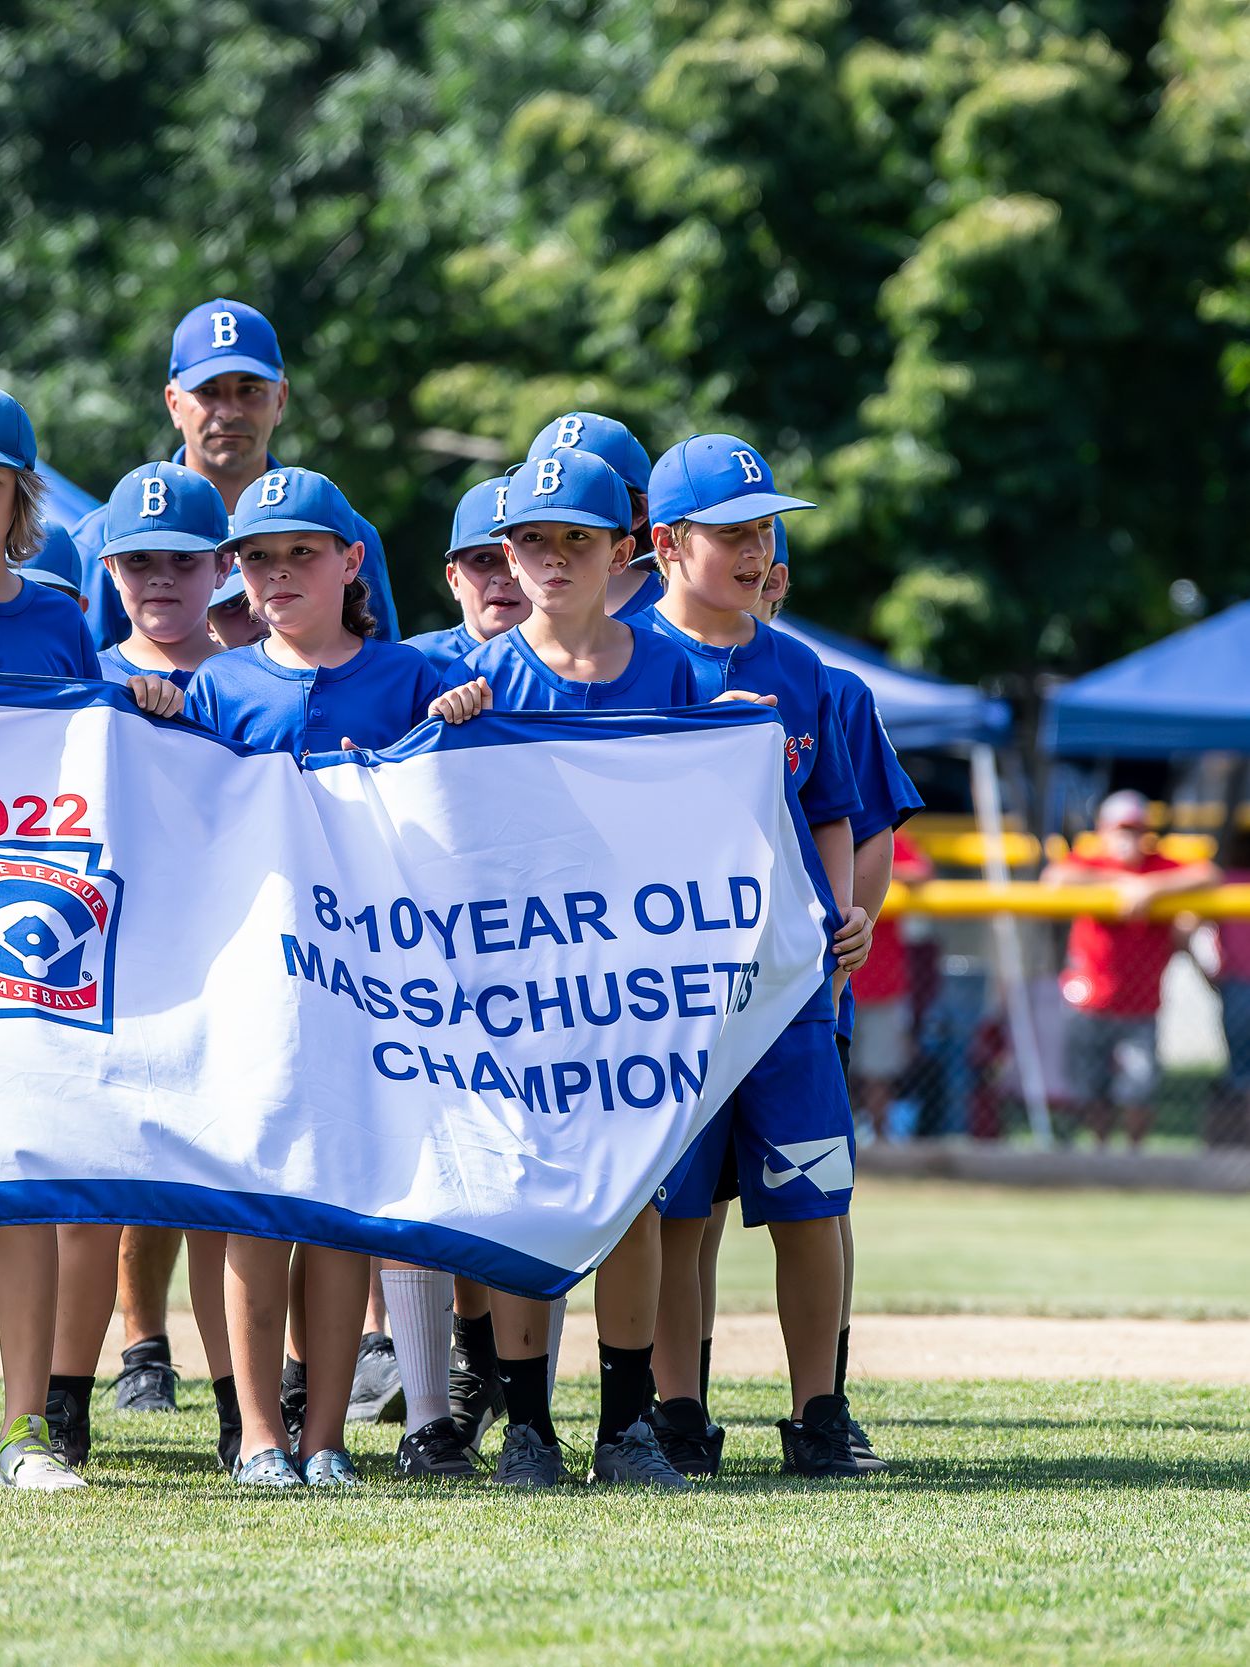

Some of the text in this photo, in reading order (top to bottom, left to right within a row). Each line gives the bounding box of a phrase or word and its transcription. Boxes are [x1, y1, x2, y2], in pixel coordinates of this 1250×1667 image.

[209, 311, 238, 348] B
[551, 415, 584, 451] B
[532, 457, 563, 496] B
[730, 450, 763, 484] B
[138, 477, 167, 517] B
[255, 472, 288, 508] B
[21, 866, 104, 913] LEAGUE
[424, 891, 618, 960] YEAR
[634, 876, 762, 936] OLD
[280, 933, 760, 1037] MASSACHUSETTS
[372, 1041, 708, 1115] CHAMPION
